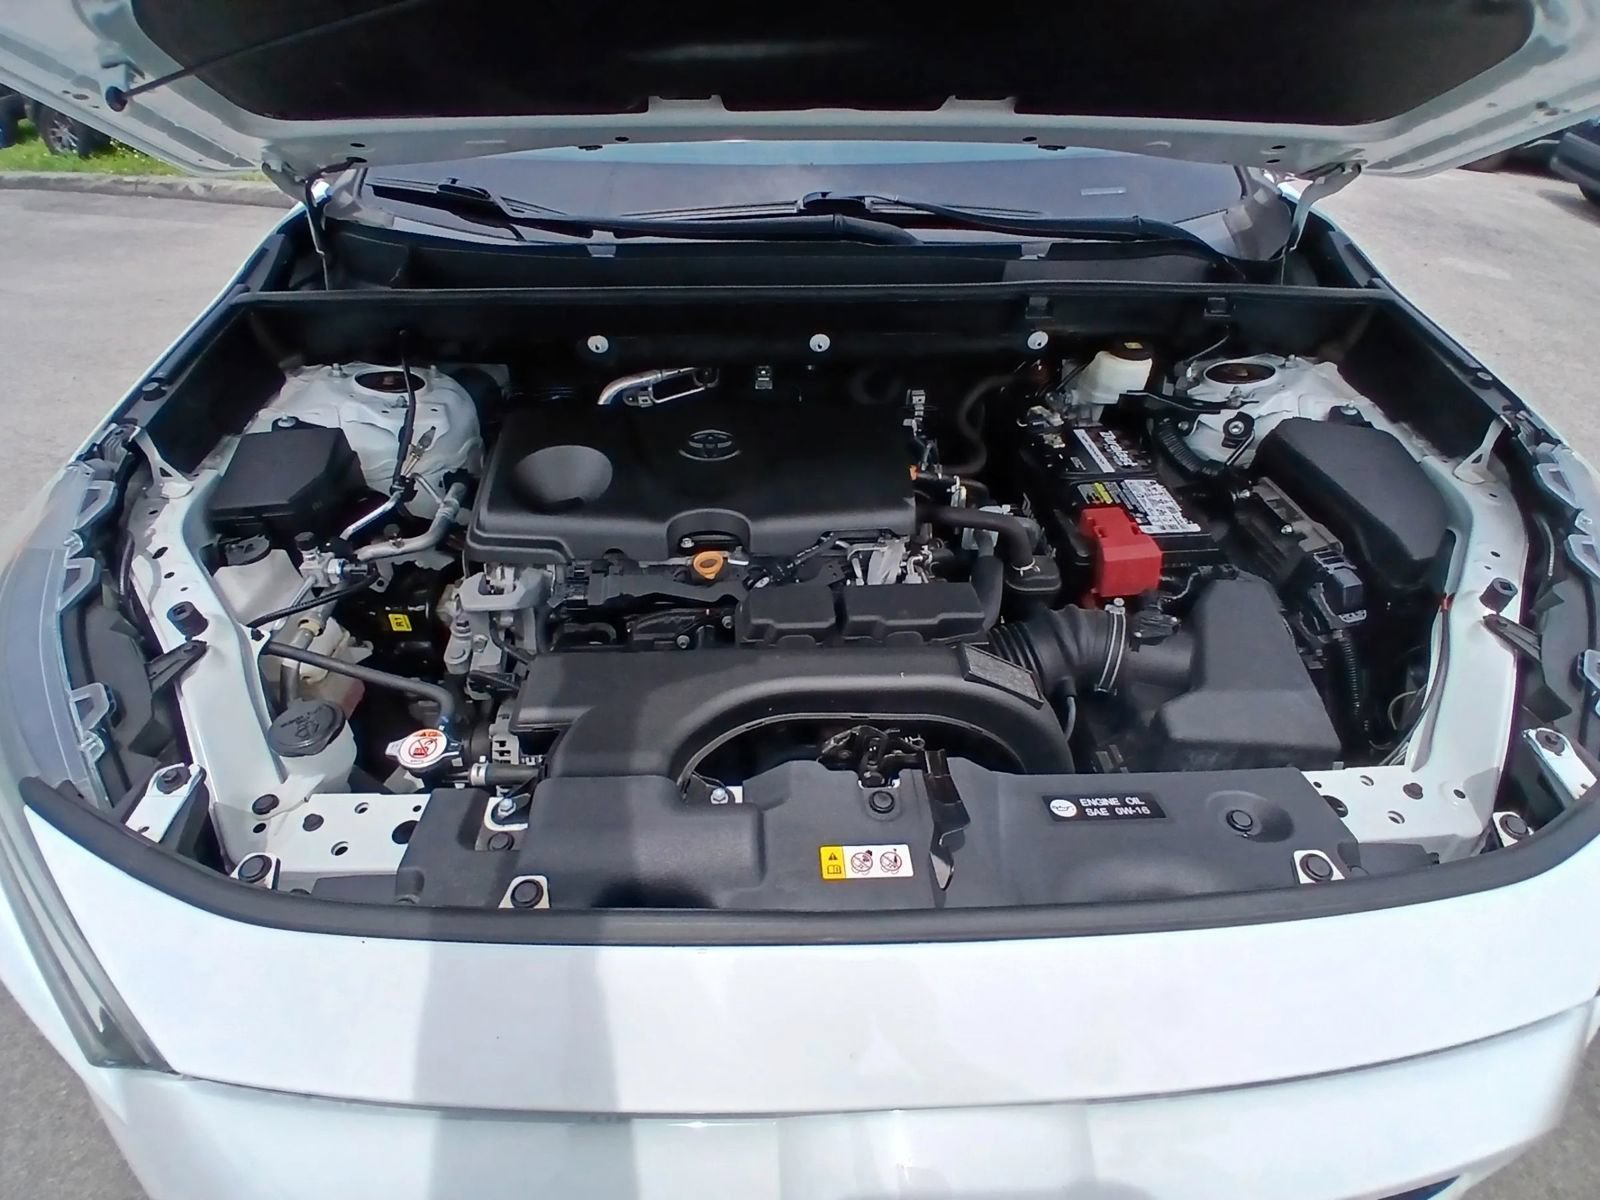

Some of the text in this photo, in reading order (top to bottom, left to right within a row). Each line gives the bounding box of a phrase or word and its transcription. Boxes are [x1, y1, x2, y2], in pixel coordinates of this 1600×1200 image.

[1079, 797, 1144, 807] ENGINE OIL
[1085, 808, 1109, 816] SAE
